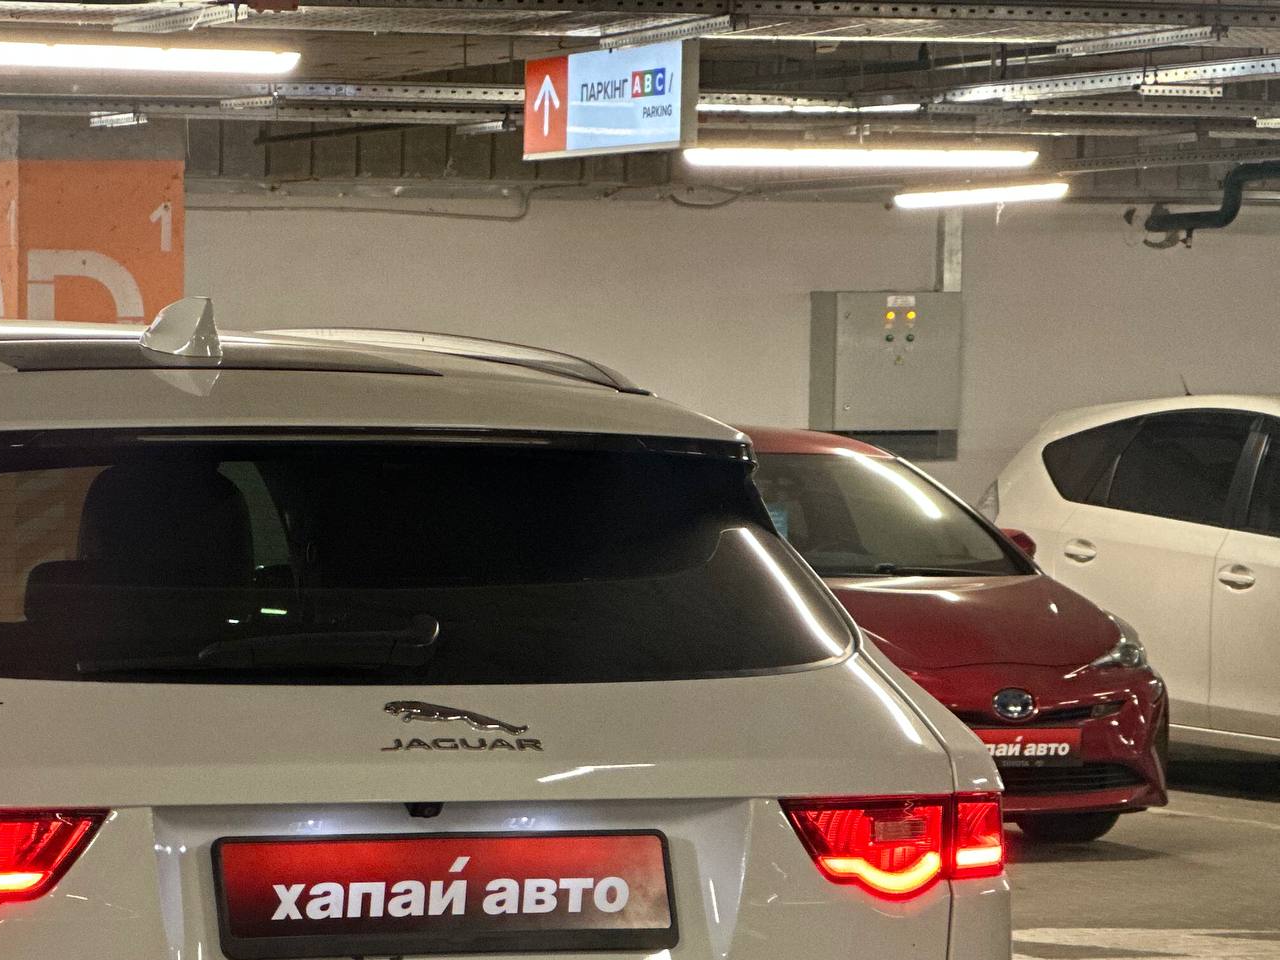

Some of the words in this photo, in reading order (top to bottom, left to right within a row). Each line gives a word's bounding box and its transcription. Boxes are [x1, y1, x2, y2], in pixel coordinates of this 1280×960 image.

[581, 79, 628, 102] ПАРКІНГ
[642, 105, 672, 118] PARKING
[149, 201, 172, 251] 1
[381, 738, 543, 751] JAGUAR
[1024, 743, 1070, 757] авто
[272, 856, 470, 920] хапай
[482, 876, 630, 916] авто
